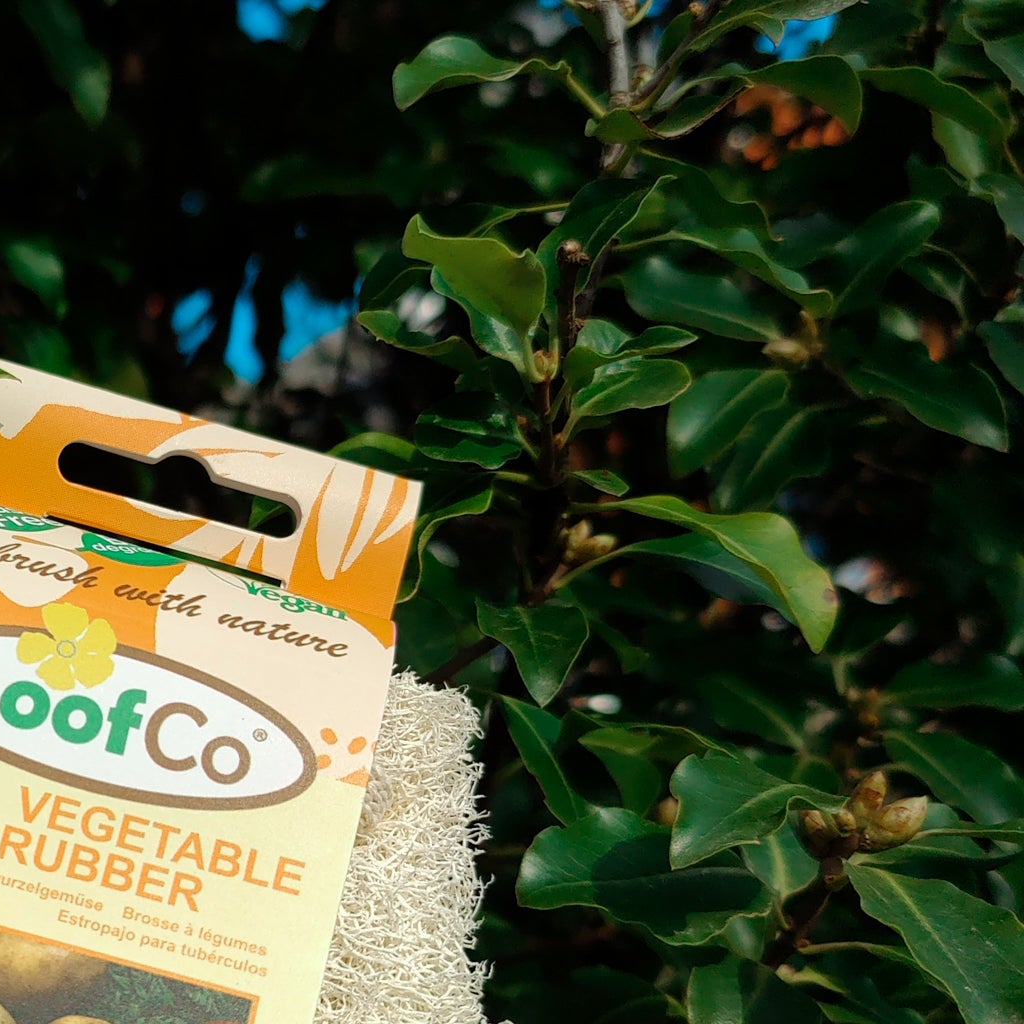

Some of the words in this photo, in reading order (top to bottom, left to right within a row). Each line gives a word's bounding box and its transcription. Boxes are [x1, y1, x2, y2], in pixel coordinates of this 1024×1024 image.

[113, 583, 208, 618] with
[218, 613, 349, 658] nature
[242, 580, 348, 621] Vegan
[19, 785, 306, 897] VEGETABLE
[57, 909, 136, 942] Estropajo
[139, 934, 176, 953] para
[181, 942, 268, 978] tubérculos
[122, 905, 180, 933] Brosse
[183, 922, 194, 937] à
[198, 926, 268, 957] légumes
